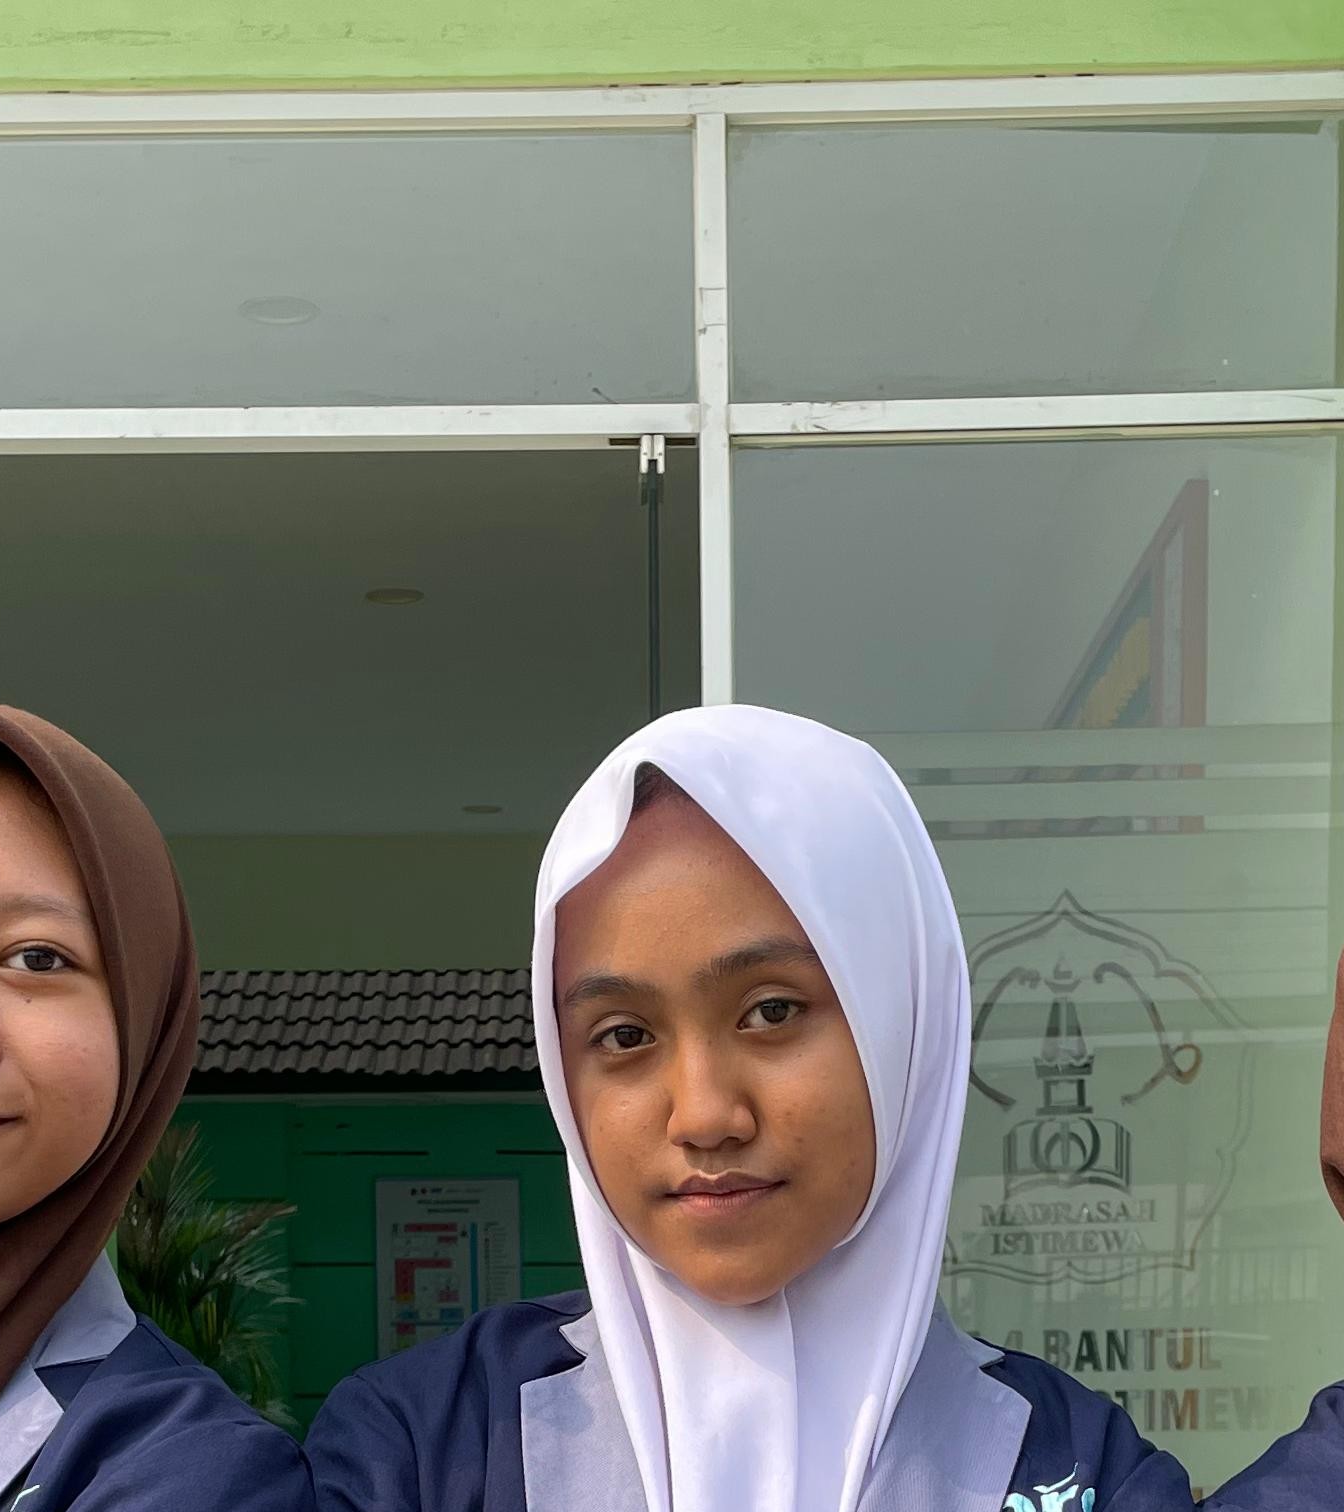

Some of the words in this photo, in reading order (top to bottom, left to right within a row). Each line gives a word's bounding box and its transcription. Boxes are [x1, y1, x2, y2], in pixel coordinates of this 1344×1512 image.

[979, 1200, 1157, 1228] MADRASAH
[991, 1229, 1147, 1256] ISTIMEWA
[1043, 1328, 1223, 1373] BANTUL
